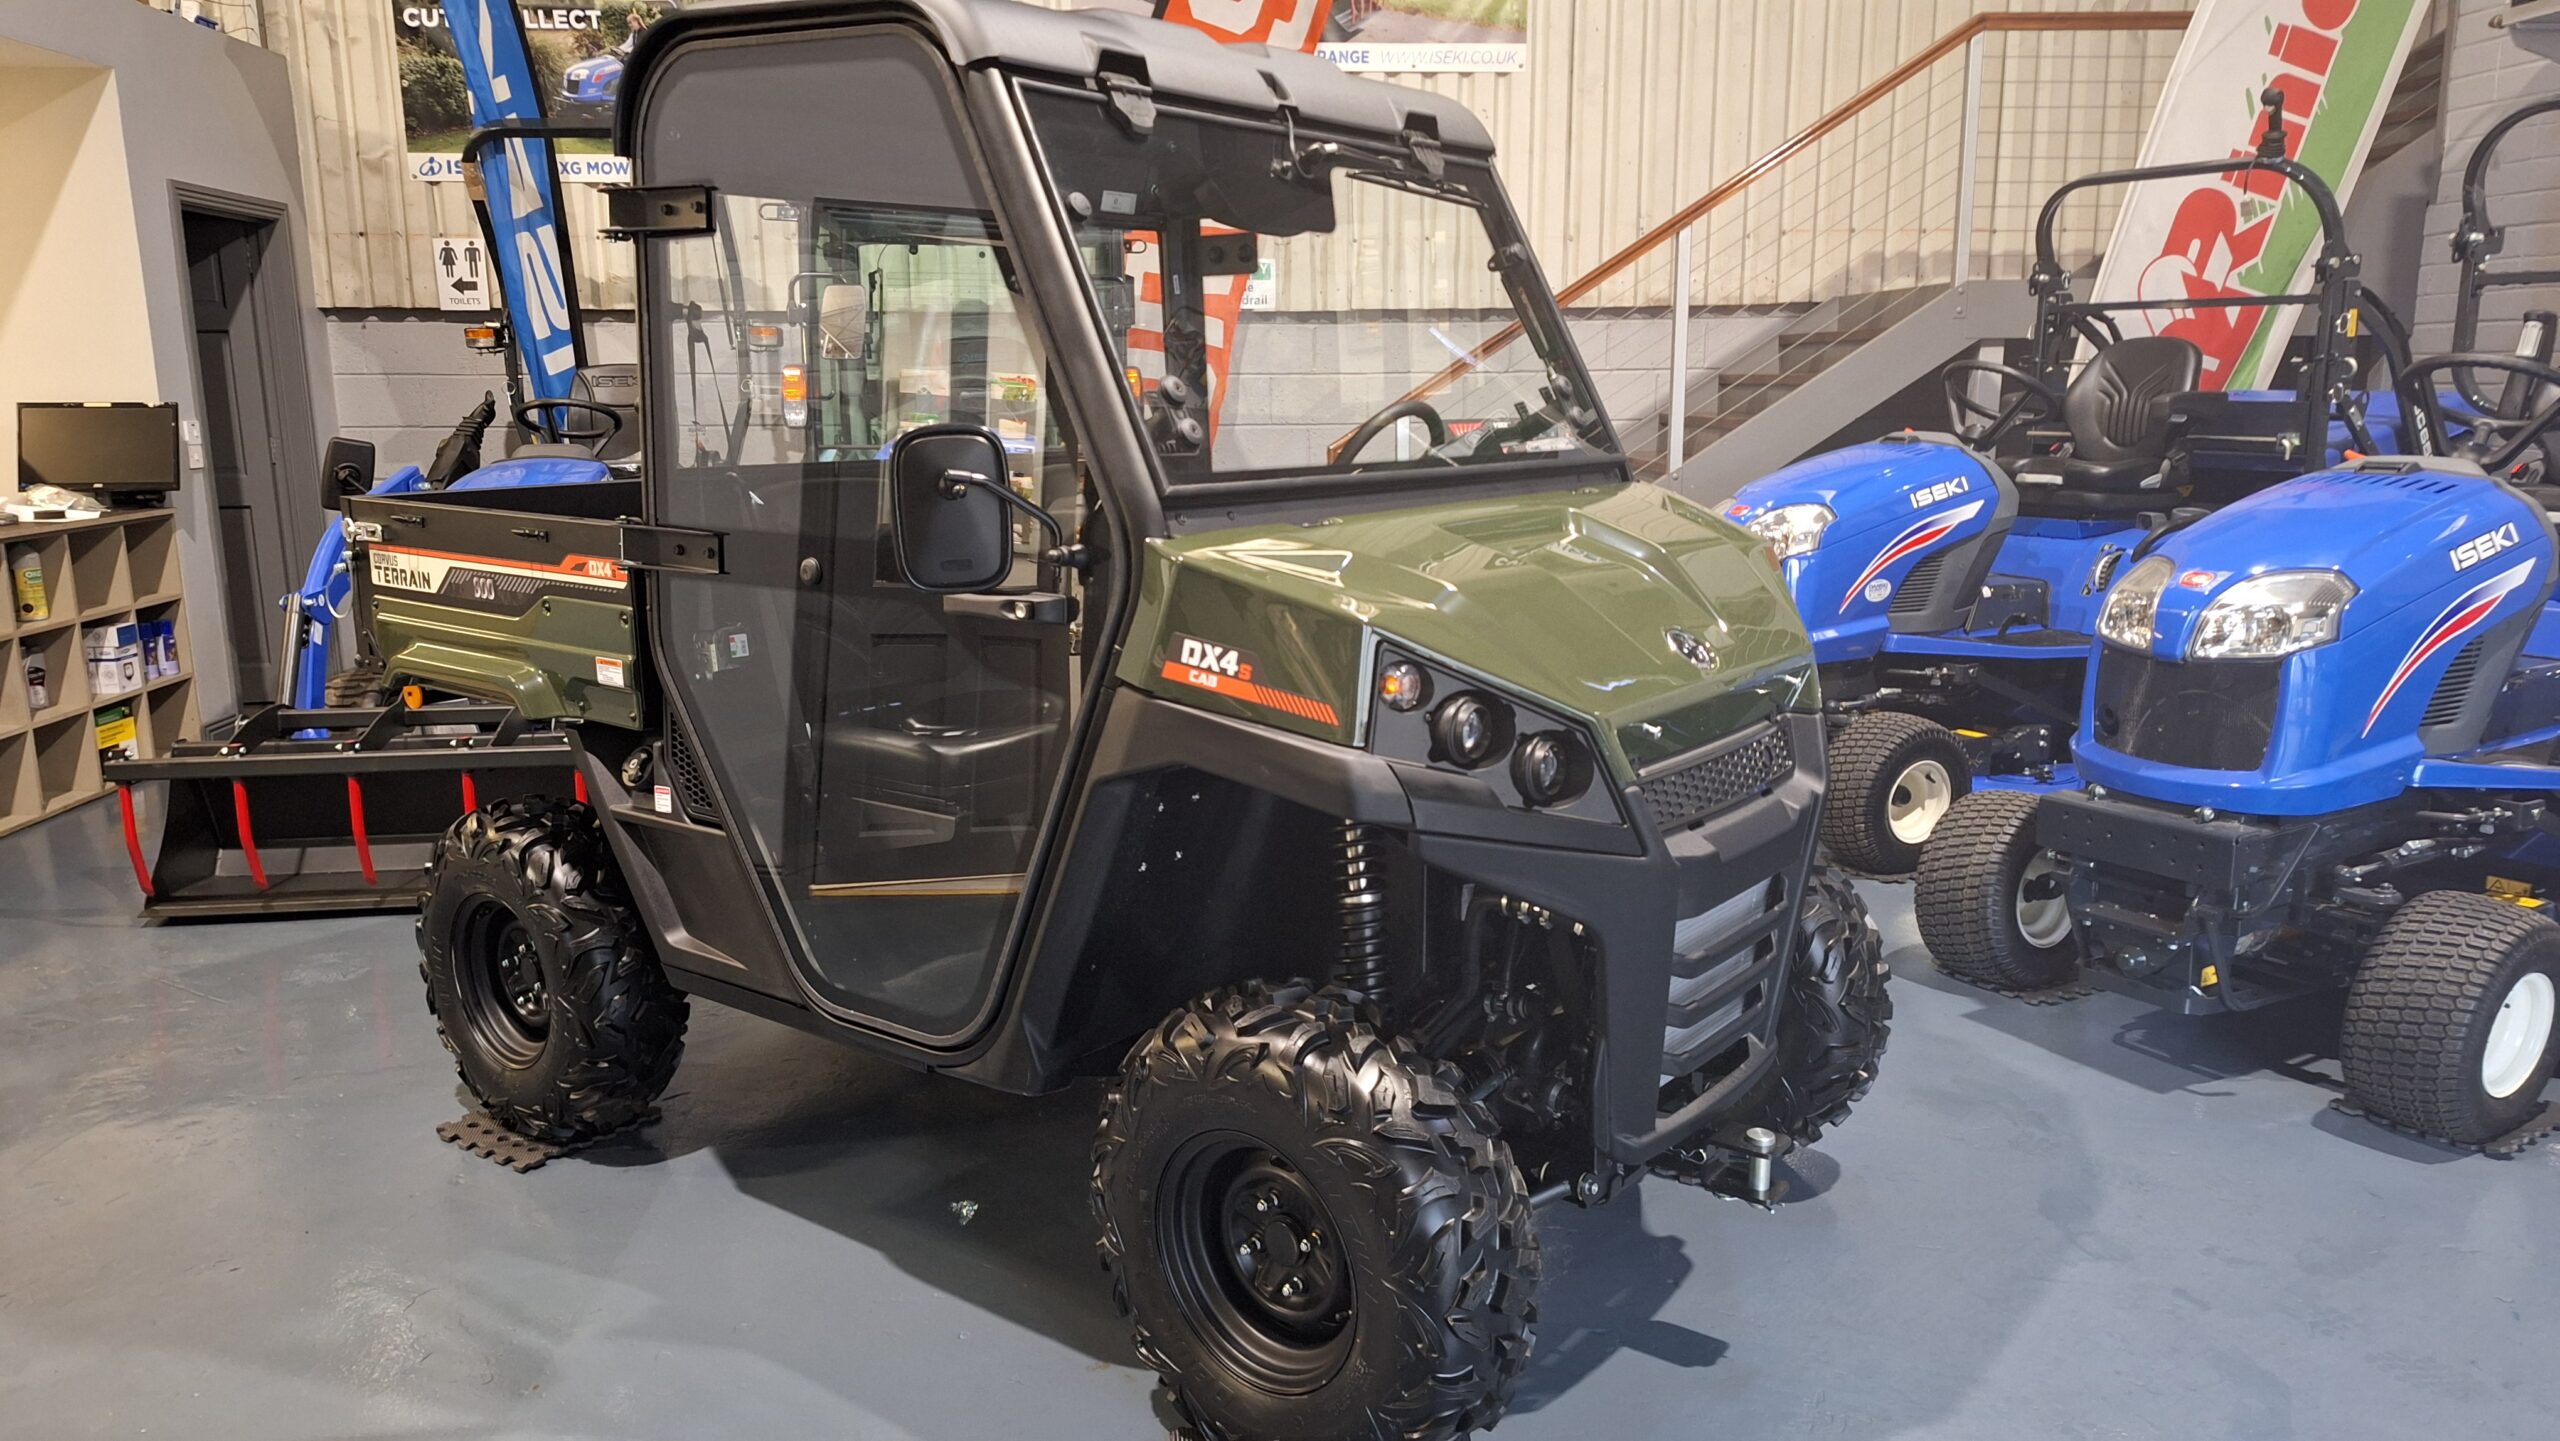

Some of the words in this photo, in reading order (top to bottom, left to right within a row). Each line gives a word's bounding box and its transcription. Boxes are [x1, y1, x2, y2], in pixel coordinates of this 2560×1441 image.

[1380, 50, 1519, 65] WWW.ISEKI.CO.UK
[450, 297, 481, 305] TOILETS
[1910, 475, 1970, 509] ISEKI
[2449, 521, 2520, 573] ISEKI
[373, 552, 398, 567] CORVUS
[374, 564, 432, 590] TERRAIN
[1188, 670, 1218, 689] CAB
